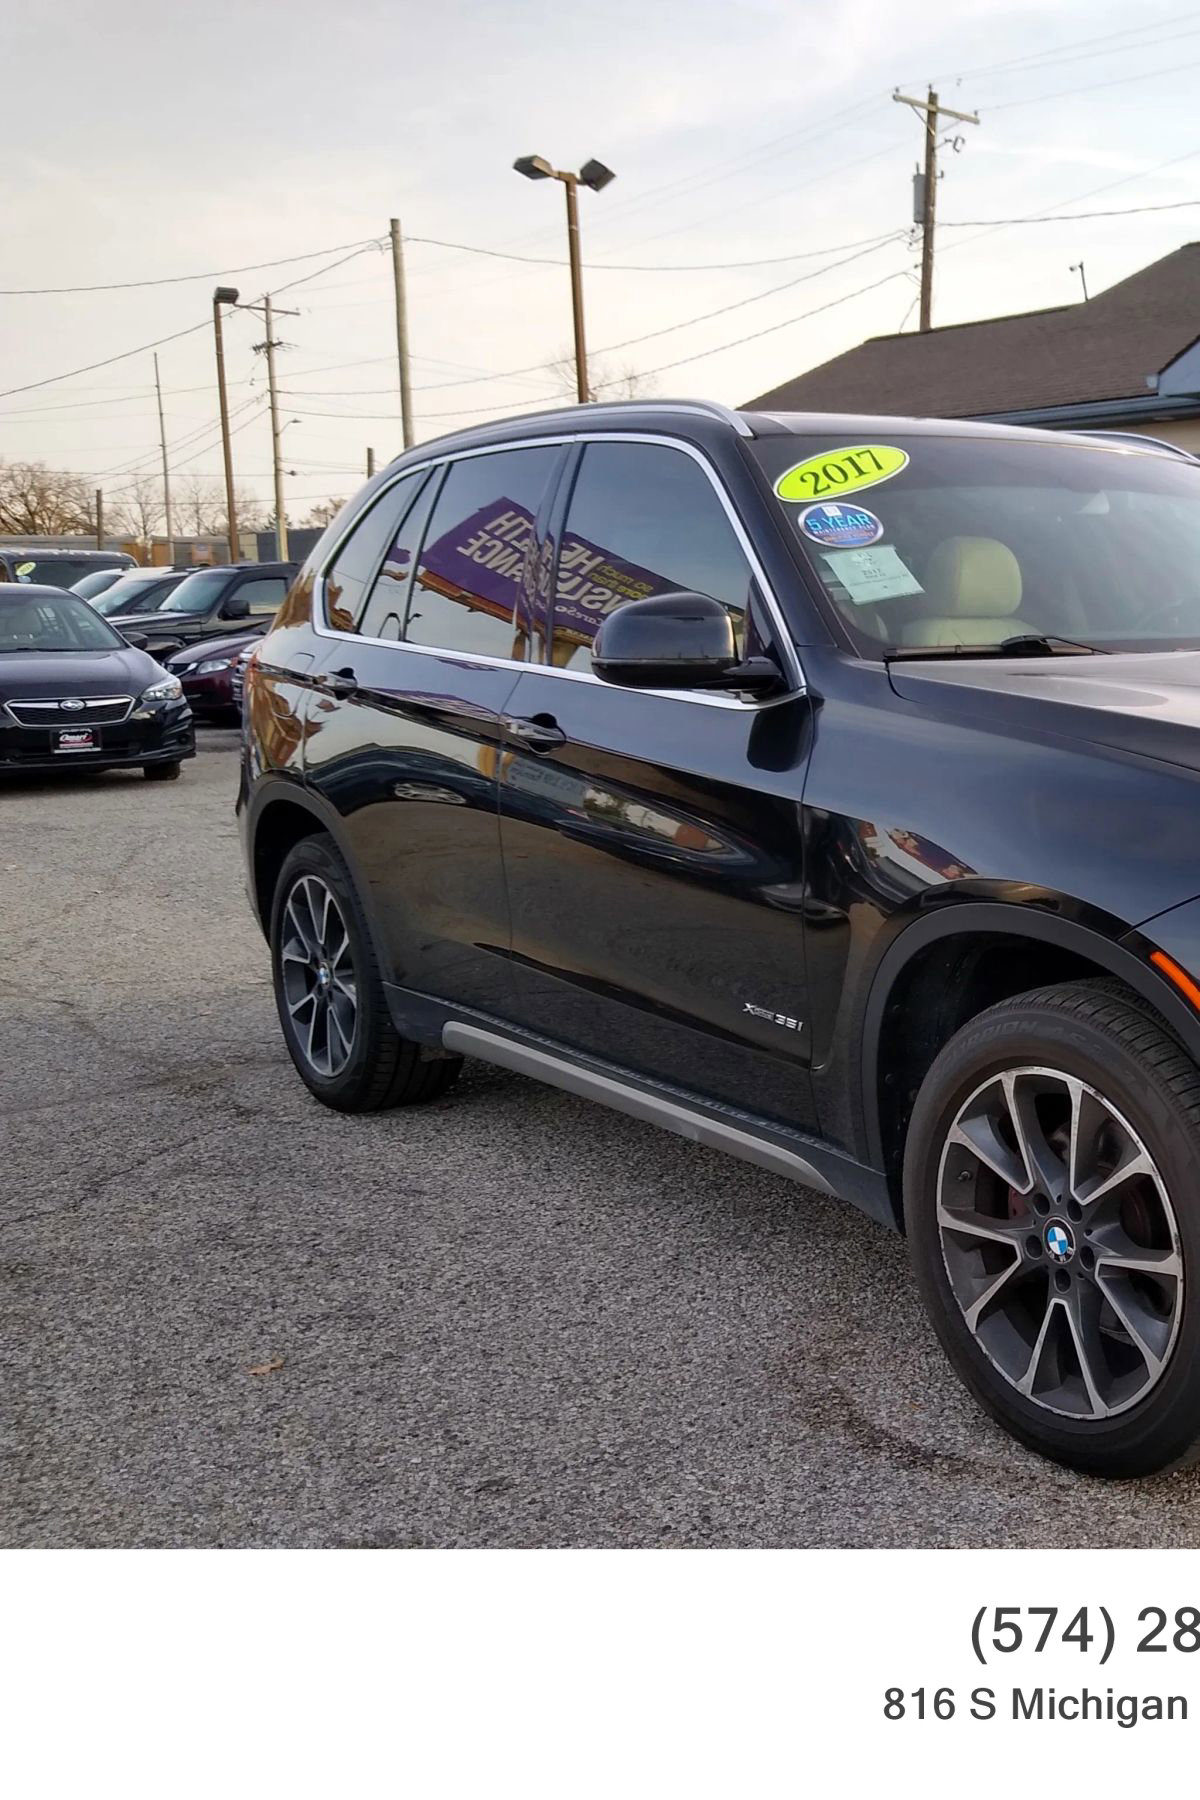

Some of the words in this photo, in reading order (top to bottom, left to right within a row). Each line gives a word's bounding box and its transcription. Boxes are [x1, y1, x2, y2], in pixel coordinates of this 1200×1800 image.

[799, 449, 884, 496] 2017
[805, 518, 823, 531] 5
[822, 513, 873, 529] YEAR
